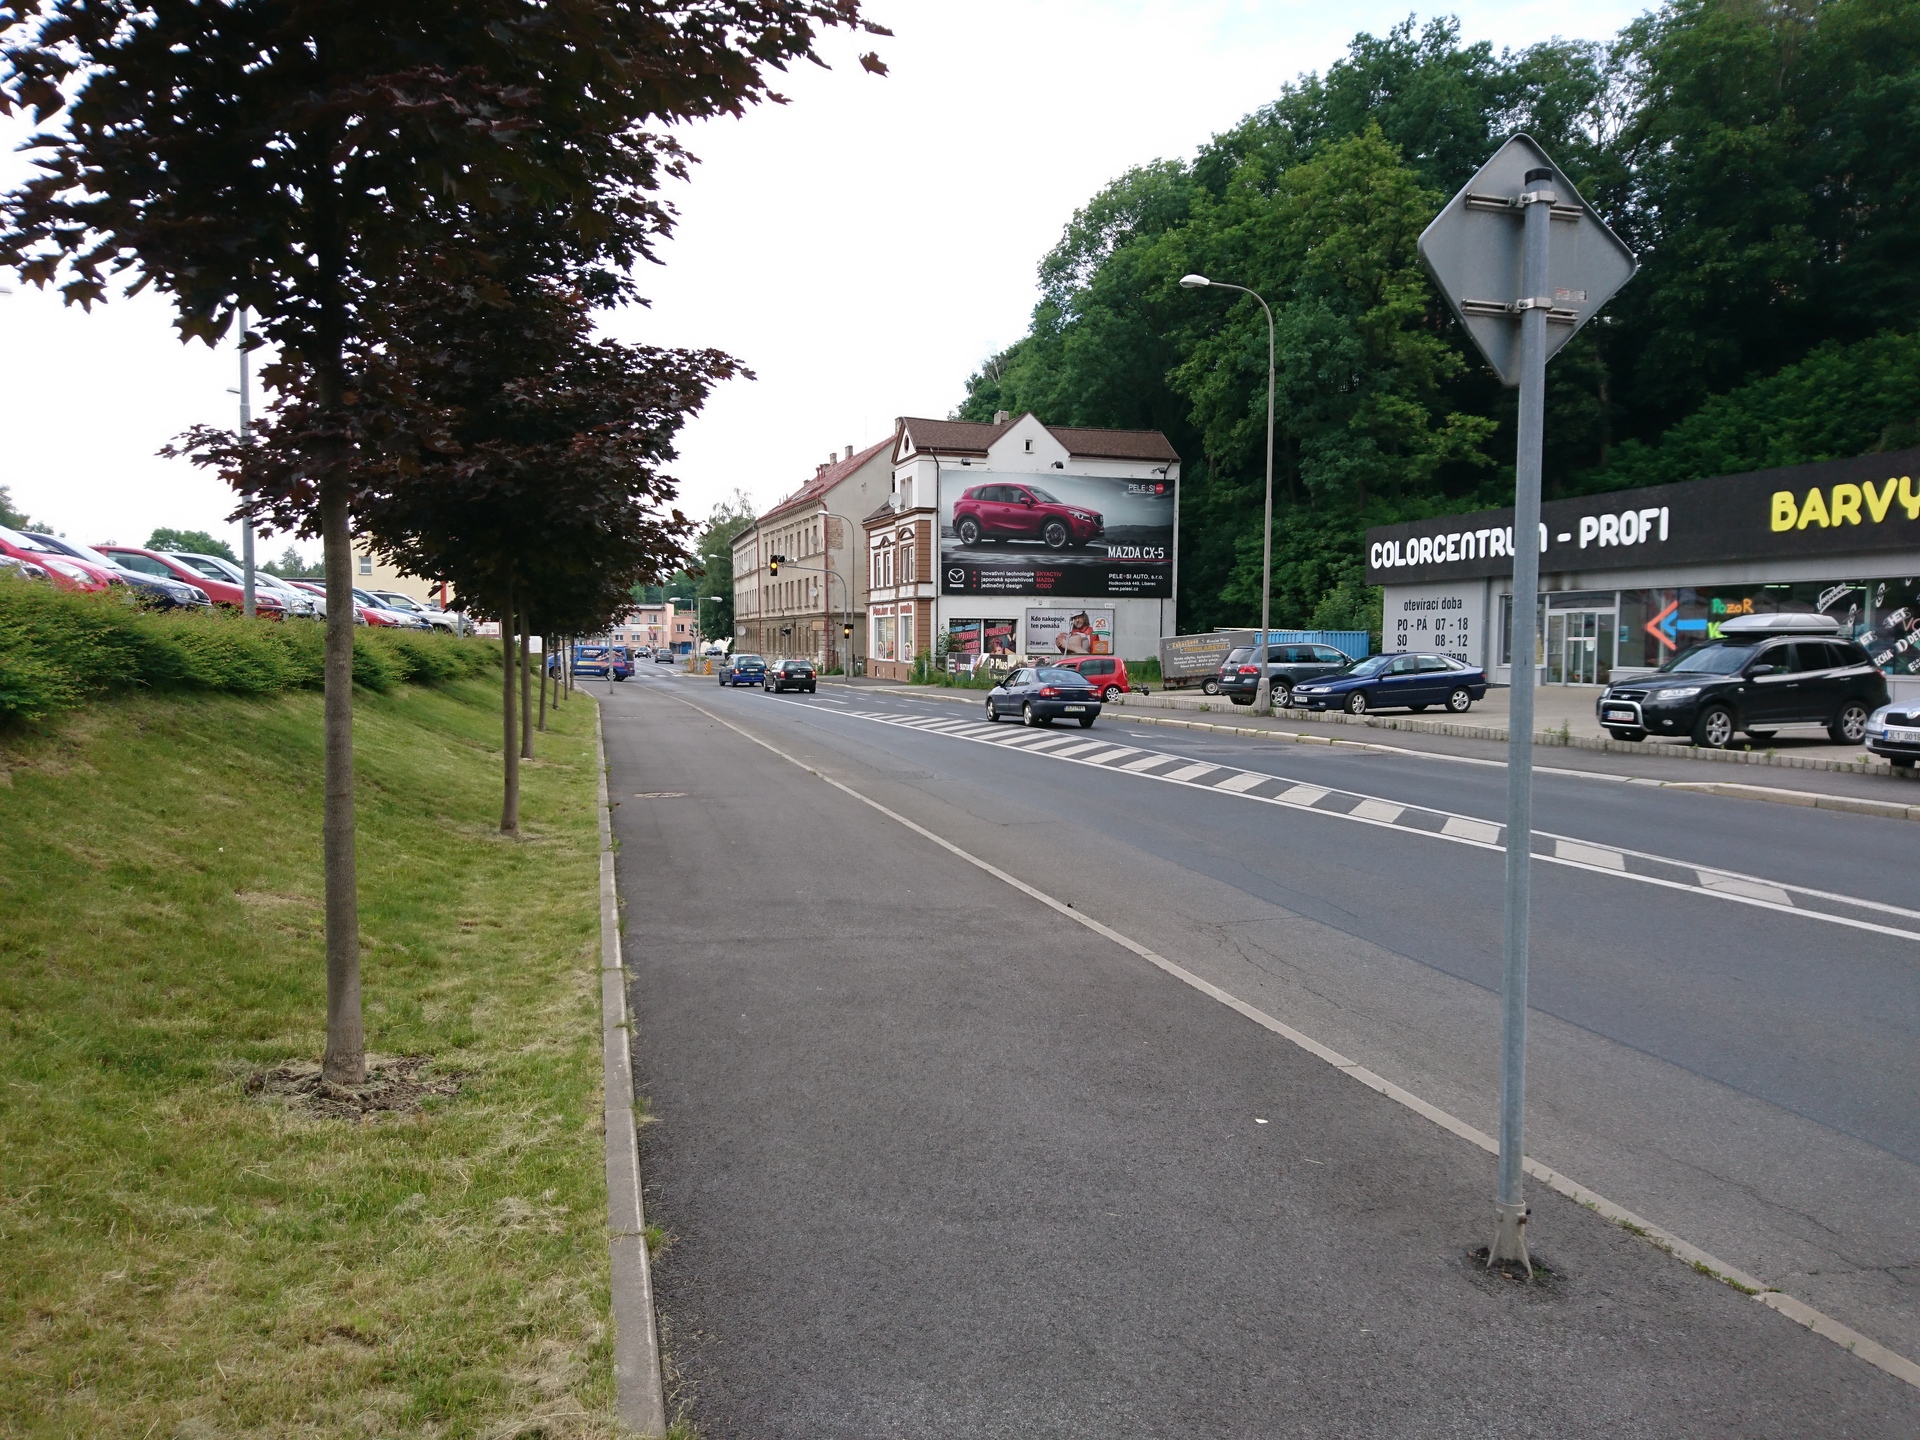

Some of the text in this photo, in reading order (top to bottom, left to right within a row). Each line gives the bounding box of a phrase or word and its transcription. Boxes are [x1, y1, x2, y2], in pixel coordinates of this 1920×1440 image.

[1771, 476, 1920, 532] BARVY
[1579, 506, 1670, 549] PROFI
[1108, 546, 1164, 559] MAZDA CX-5
[1403, 597, 1462, 611] otevírací doba
[1042, 615, 1067, 623] nakupuje,
[1397, 618, 1408, 631] PO
[1416, 615, 1428, 631] PÁ
[1435, 618, 1446, 631] 07
[1457, 617, 1468, 630] 18
[1397, 634, 1407, 647] SO
[1435, 634, 1446, 647] 08
[1457, 634, 1468, 647] 12
[1873, 649, 1894, 666] ECHA
